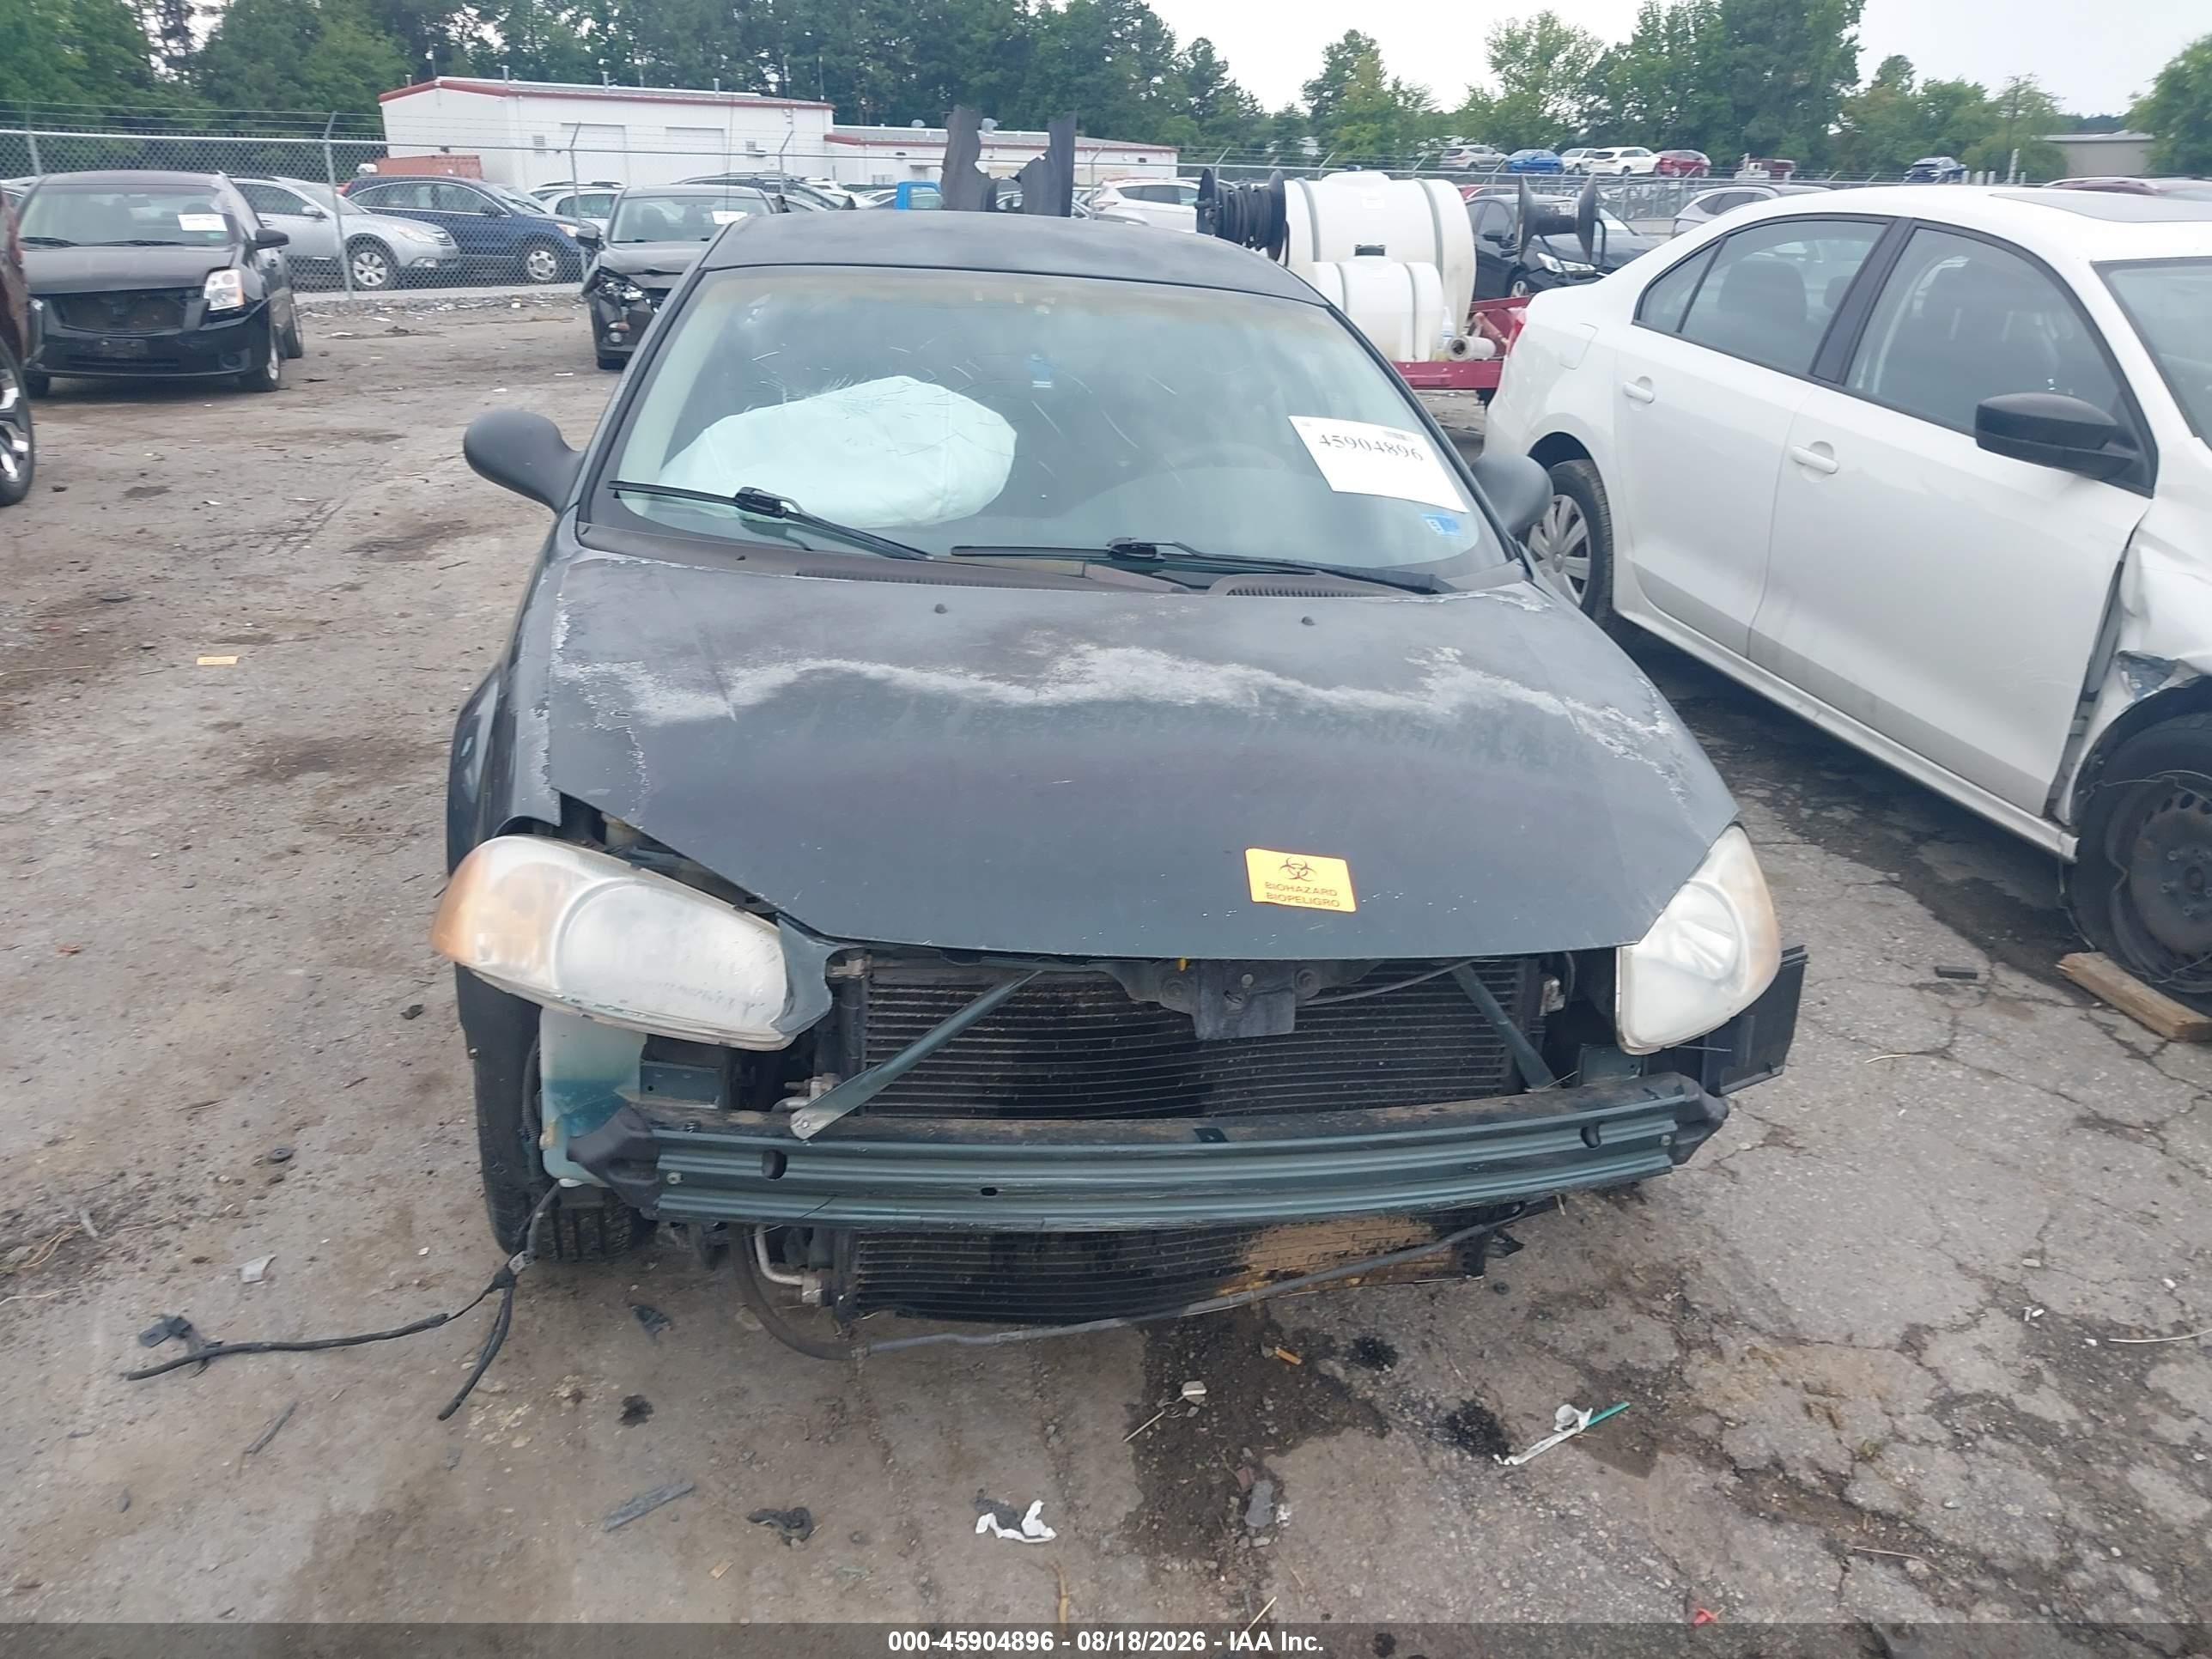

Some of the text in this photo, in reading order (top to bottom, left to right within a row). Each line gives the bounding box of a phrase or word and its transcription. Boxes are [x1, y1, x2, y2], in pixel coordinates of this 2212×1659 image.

[1319, 434, 1425, 461] 45904896
[1265, 881, 1338, 896] BIOHAZARD
[1266, 891, 1340, 907] BIOPELIGRO
